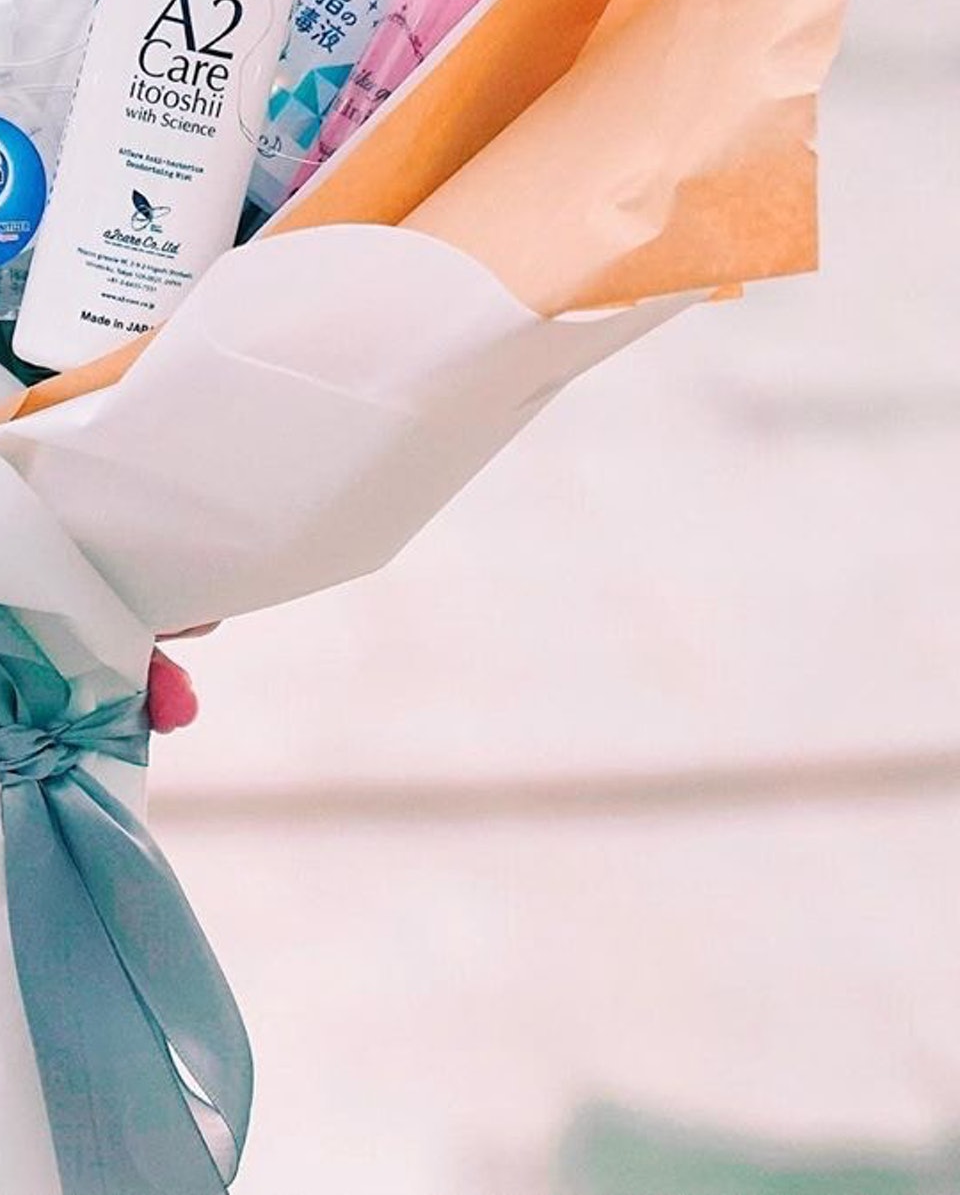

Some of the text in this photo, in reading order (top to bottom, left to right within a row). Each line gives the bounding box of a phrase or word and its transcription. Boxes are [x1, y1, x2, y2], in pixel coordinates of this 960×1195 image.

[293, 0, 346, 54] 毒液
[138, 38, 229, 92] Care
[125, 106, 217, 138] with Science
[81, 311, 154, 334] Made in JAP
